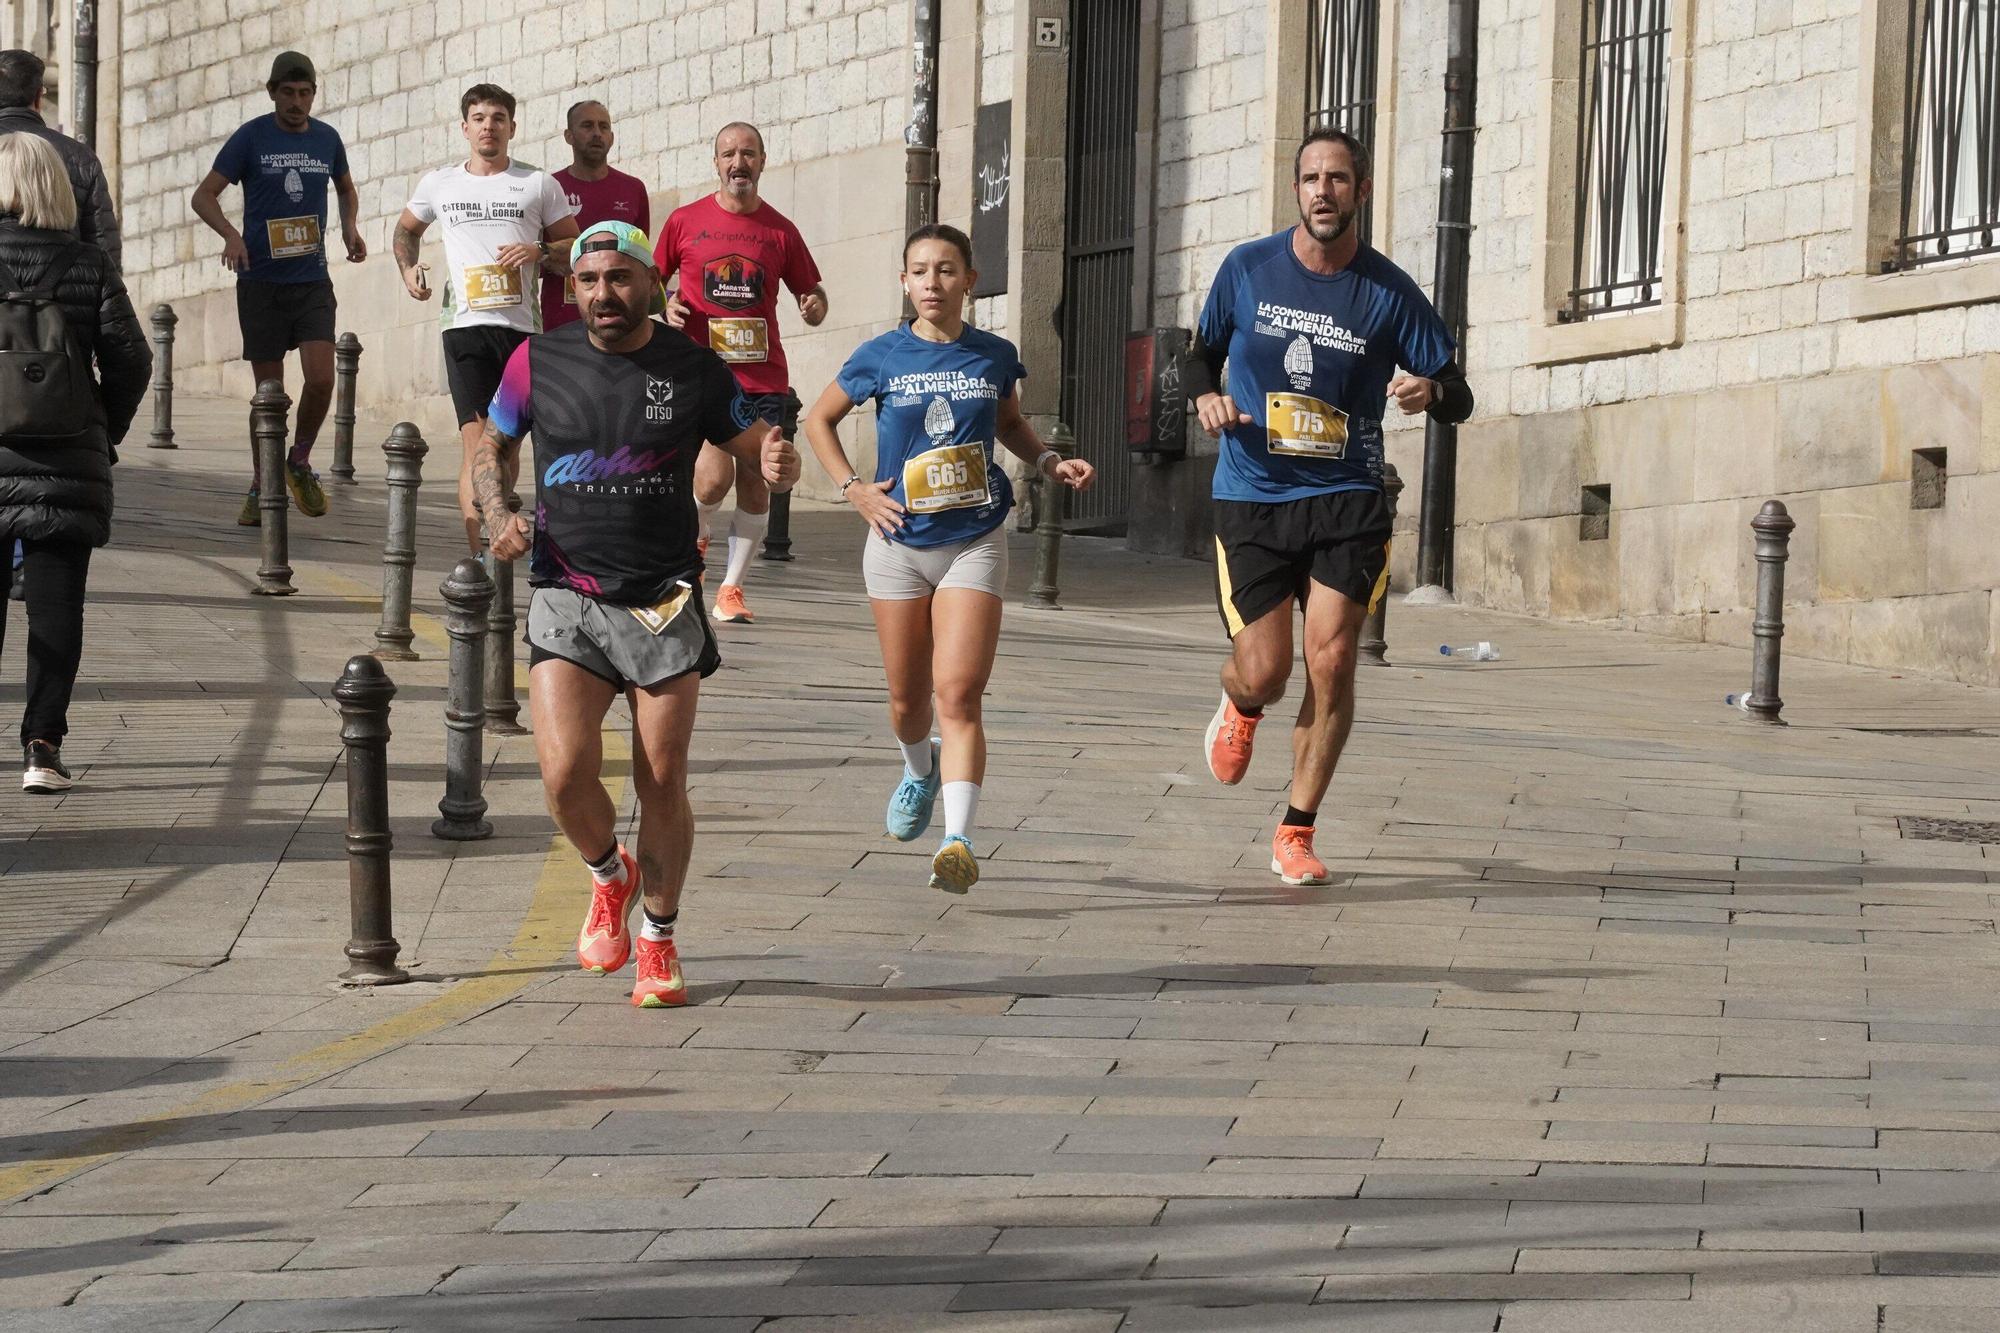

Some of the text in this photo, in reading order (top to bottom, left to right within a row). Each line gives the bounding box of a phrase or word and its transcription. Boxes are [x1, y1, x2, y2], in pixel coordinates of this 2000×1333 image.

[1041, 22, 1056, 42] 3
[272, 160, 322, 168] ALMENDRA
[492, 209, 525, 219] GORBEA
[284, 226, 308, 242] 641
[481, 273, 508, 292] 251
[1258, 301, 1334, 326] LA CONQUISTA
[1266, 311, 1275, 319] LA
[1271, 314, 1353, 343] ALMENDRA
[1353, 337, 1367, 346] REN
[725, 329, 754, 346] 549
[1312, 335, 1366, 356] KONKISTA
[889, 371, 966, 386] LA CONQUISTA
[904, 378, 989, 396] ALMENDRA
[1290, 379, 1312, 388] GASTEIZ
[951, 390, 999, 401] KONKISTA
[646, 405, 673, 420] OTSO
[1291, 409, 1324, 434] 175
[926, 461, 968, 488] 665
[574, 484, 675, 495] TRIATHLON
